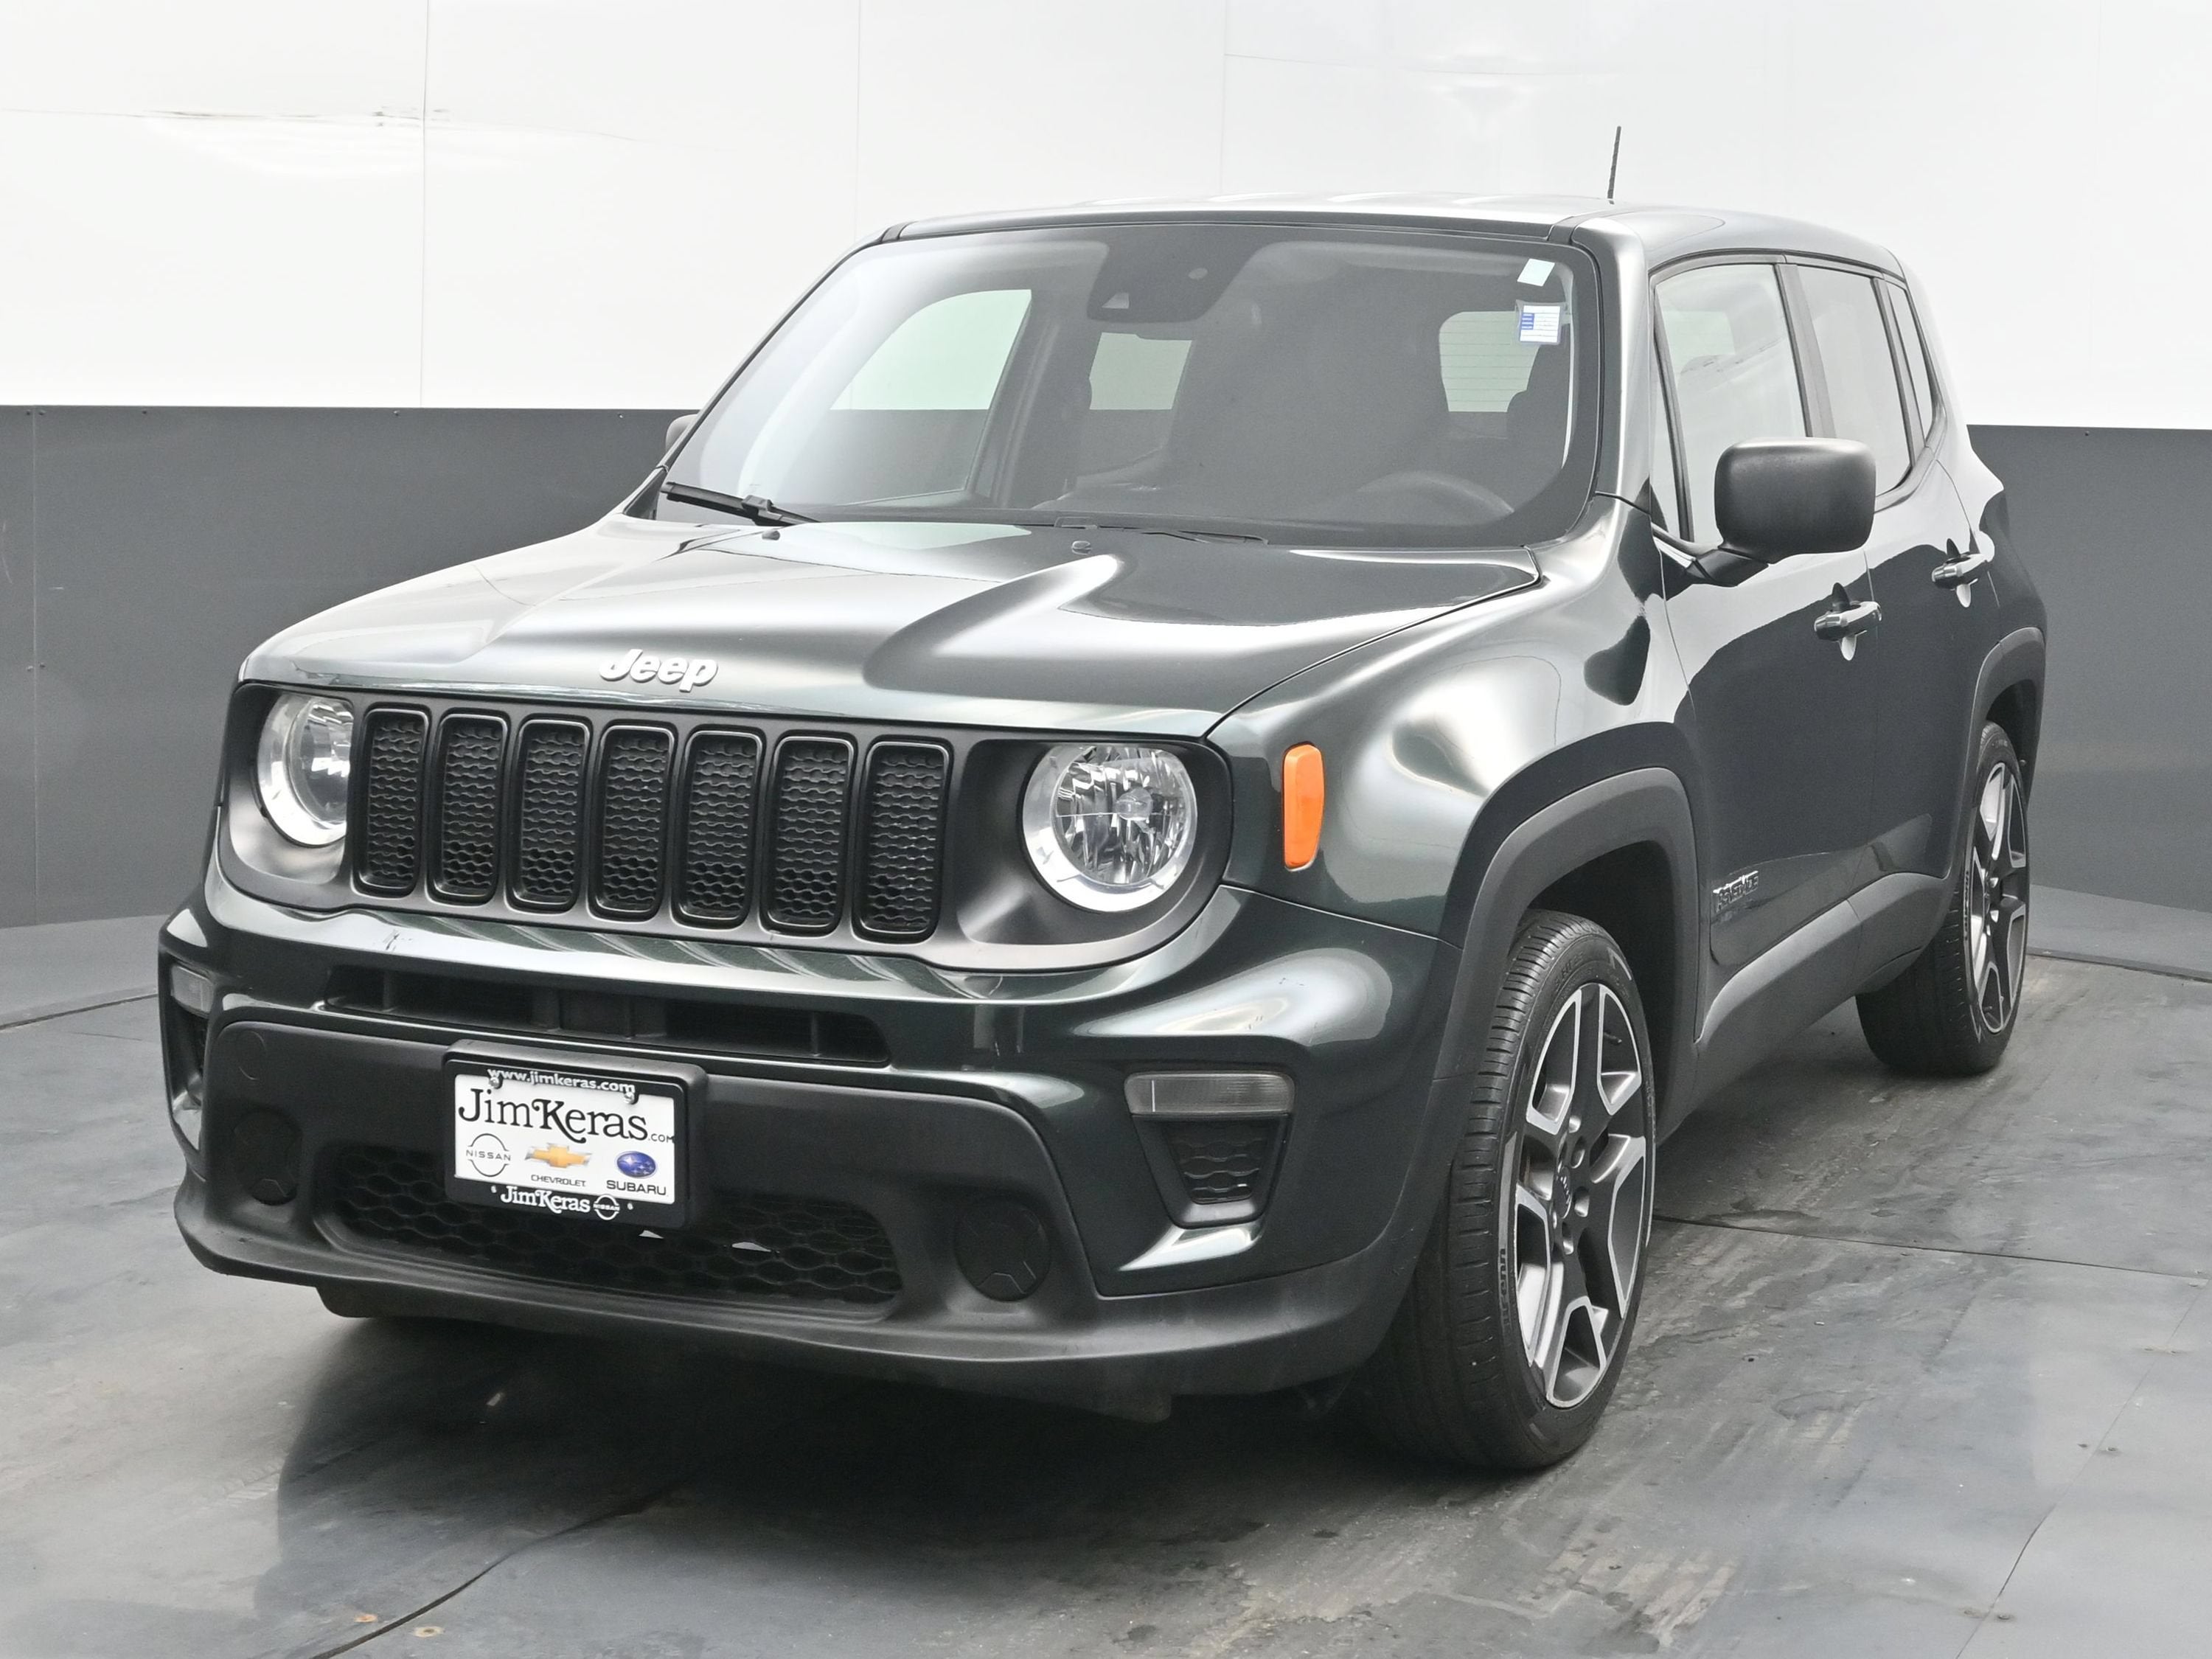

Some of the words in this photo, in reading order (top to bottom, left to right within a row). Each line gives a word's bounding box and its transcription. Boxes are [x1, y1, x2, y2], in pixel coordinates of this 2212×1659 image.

[599, 649, 718, 693] Jeep
[487, 1069, 636, 1093] www.jimkeras.com
[466, 1150, 512, 1161] NISSAN
[531, 1174, 586, 1187] CHEVROLET
[606, 1180, 667, 1196] SUBARU
